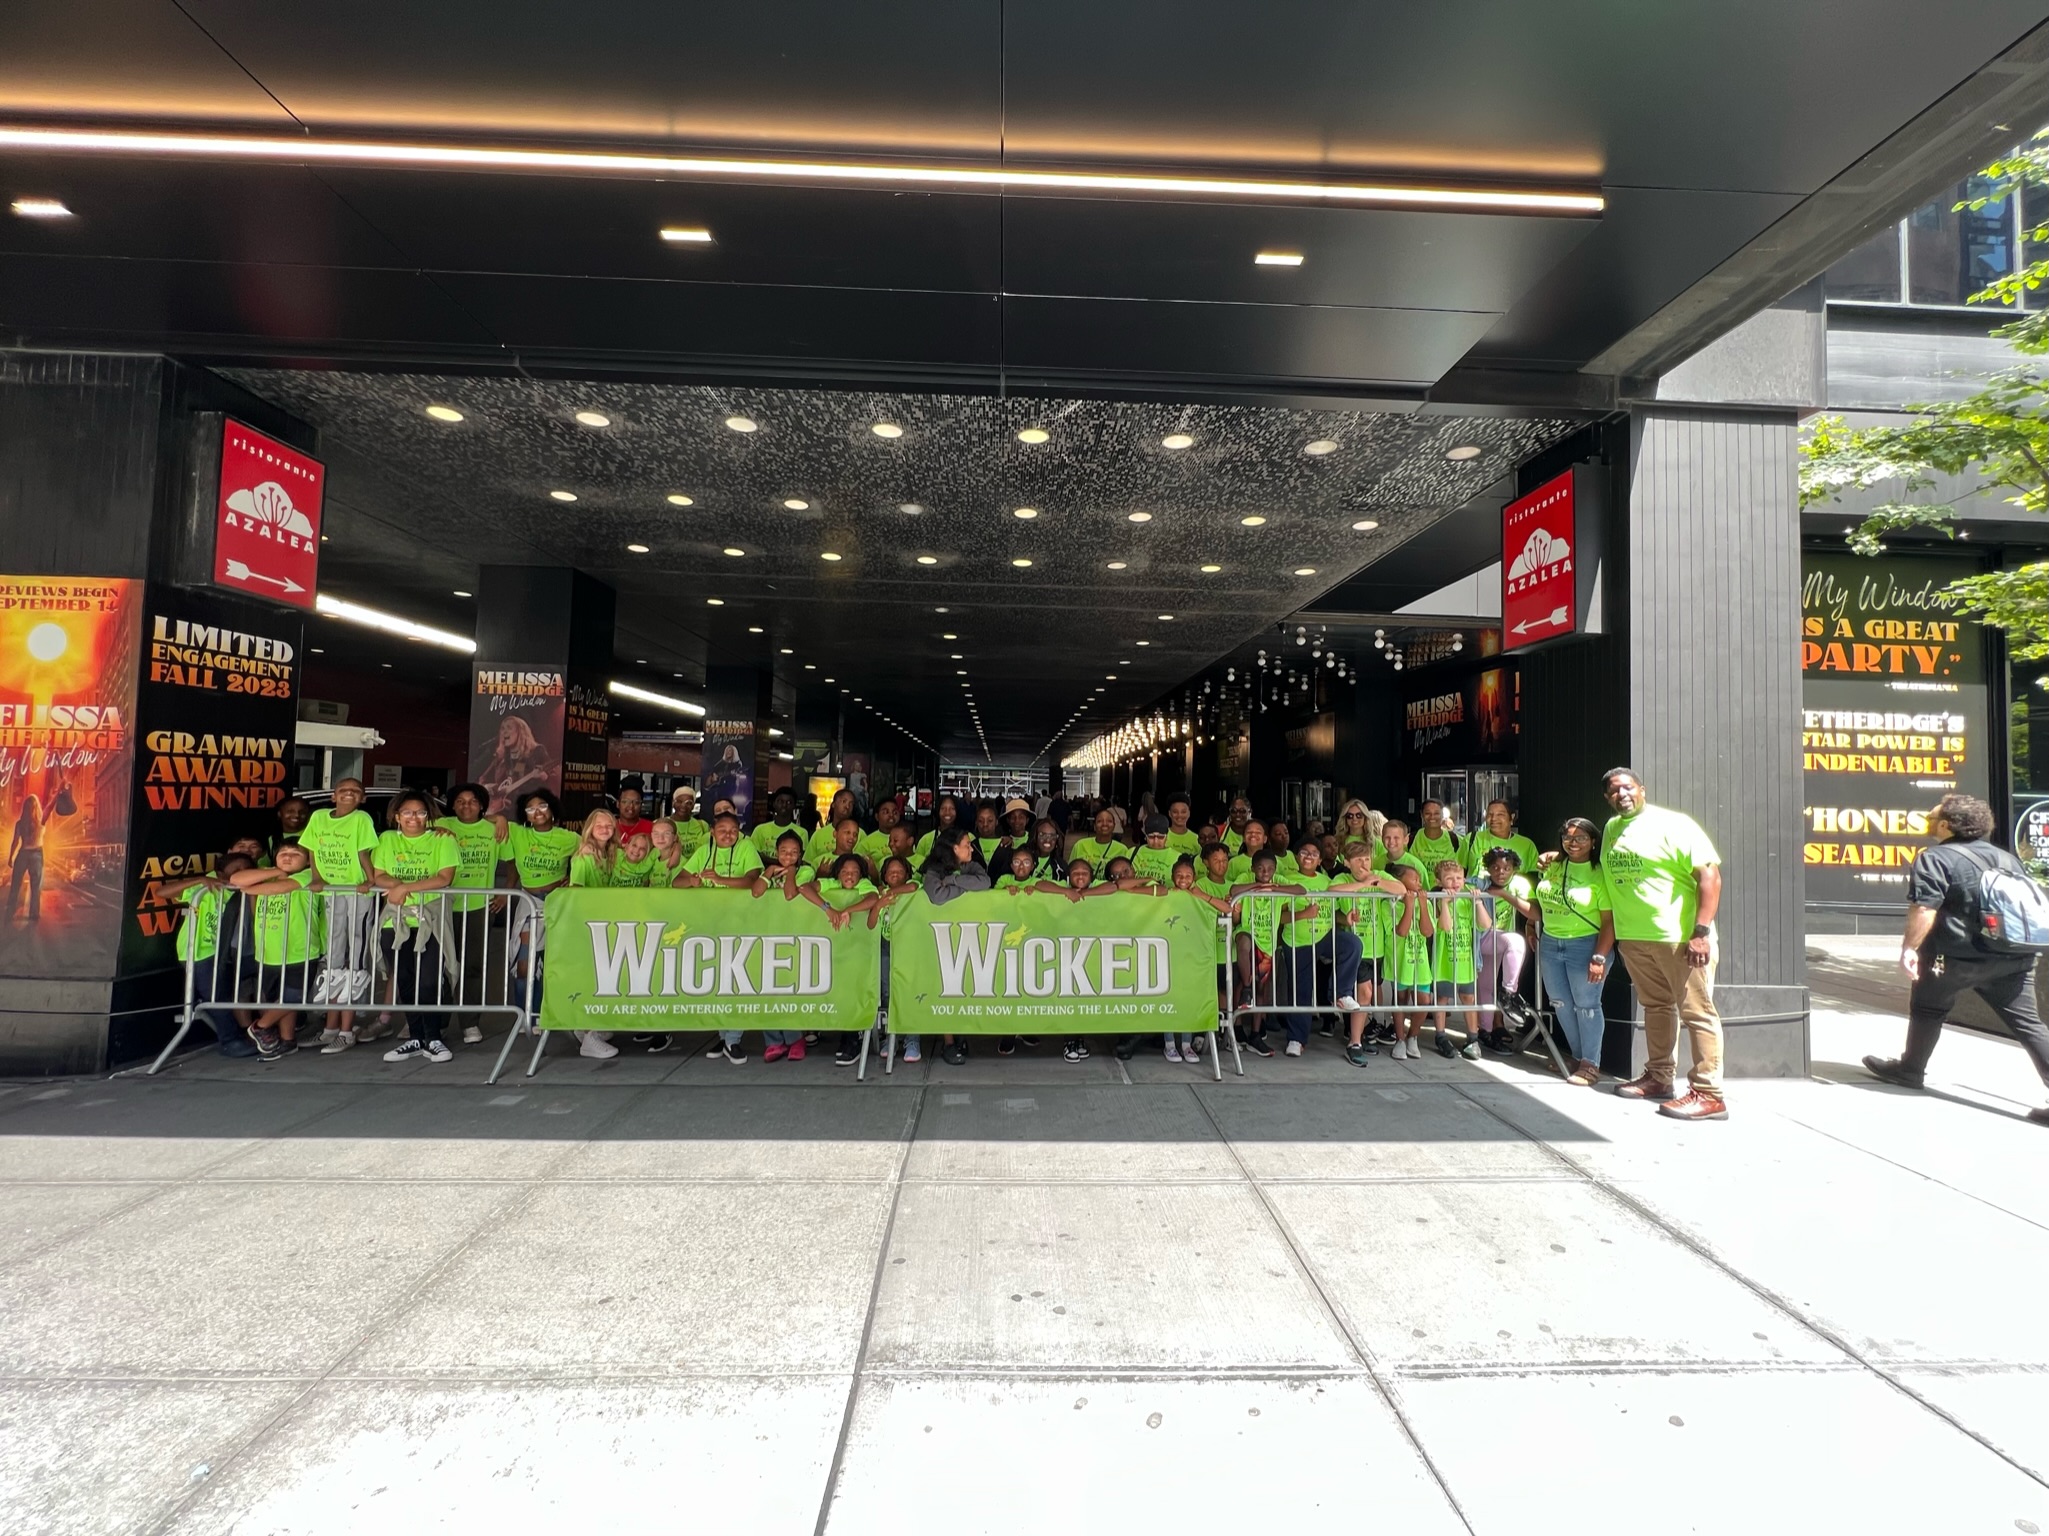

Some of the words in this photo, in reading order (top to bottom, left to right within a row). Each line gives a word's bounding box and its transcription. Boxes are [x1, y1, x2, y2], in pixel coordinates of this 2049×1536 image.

[233, 438, 315, 482] ristorante
[1509, 488, 1567, 526] ristorante
[225, 512, 314, 554] AZALEA
[1508, 559, 1572, 595] AZALEA
[72, 587, 119, 598] BEGIN
[98, 600, 119, 612] 14
[153, 615, 294, 663] LIMITED
[1833, 618, 1855, 638] A
[1864, 619, 1960, 642] GREAT
[152, 643, 292, 679] ENGAGEMENT
[150, 661, 218, 689] FALL
[226, 674, 291, 699] 2023
[477, 684, 564, 697] ETHERIDGE
[478, 671, 563, 686] MELISSA
[490, 694, 508, 715] My
[1407, 692, 1463, 719] MELISSA
[0, 704, 124, 730] ELISSA
[706, 720, 753, 728] MELISSA
[1407, 709, 1464, 731] ETHERIDGE
[0, 729, 125, 750] HERIDGE
[146, 731, 288, 758] GRAMMY
[1857, 733, 1936, 751] POWER
[1942, 736, 1965, 752] IS
[21, 739, 99, 775] Window
[146, 756, 286, 784] AWARD
[1804, 842, 1926, 866] SEARIN
[406, 867, 423, 875] ARTS
[584, 1004, 608, 1015] YOU
[612, 1004, 637, 1014] ARE
[641, 1004, 669, 1014] NOW
[673, 1004, 732, 1014] ENTERING
[736, 1003, 760, 1013] THE
[764, 1003, 797, 1013] LAND
[801, 1003, 816, 1013] OF
[819, 1003, 838, 1013] OZ.
[931, 1005, 954, 1015] YOU
[958, 1005, 982, 1015] ARE
[986, 1005, 1013, 1015] NOW
[1017, 1005, 1074, 1015] ENTERING
[1078, 1004, 1101, 1014] THE
[1105, 1004, 1138, 1014] LAND
[1141, 1004, 1156, 1014] OF
[1159, 1004, 1177, 1014] OZ.
